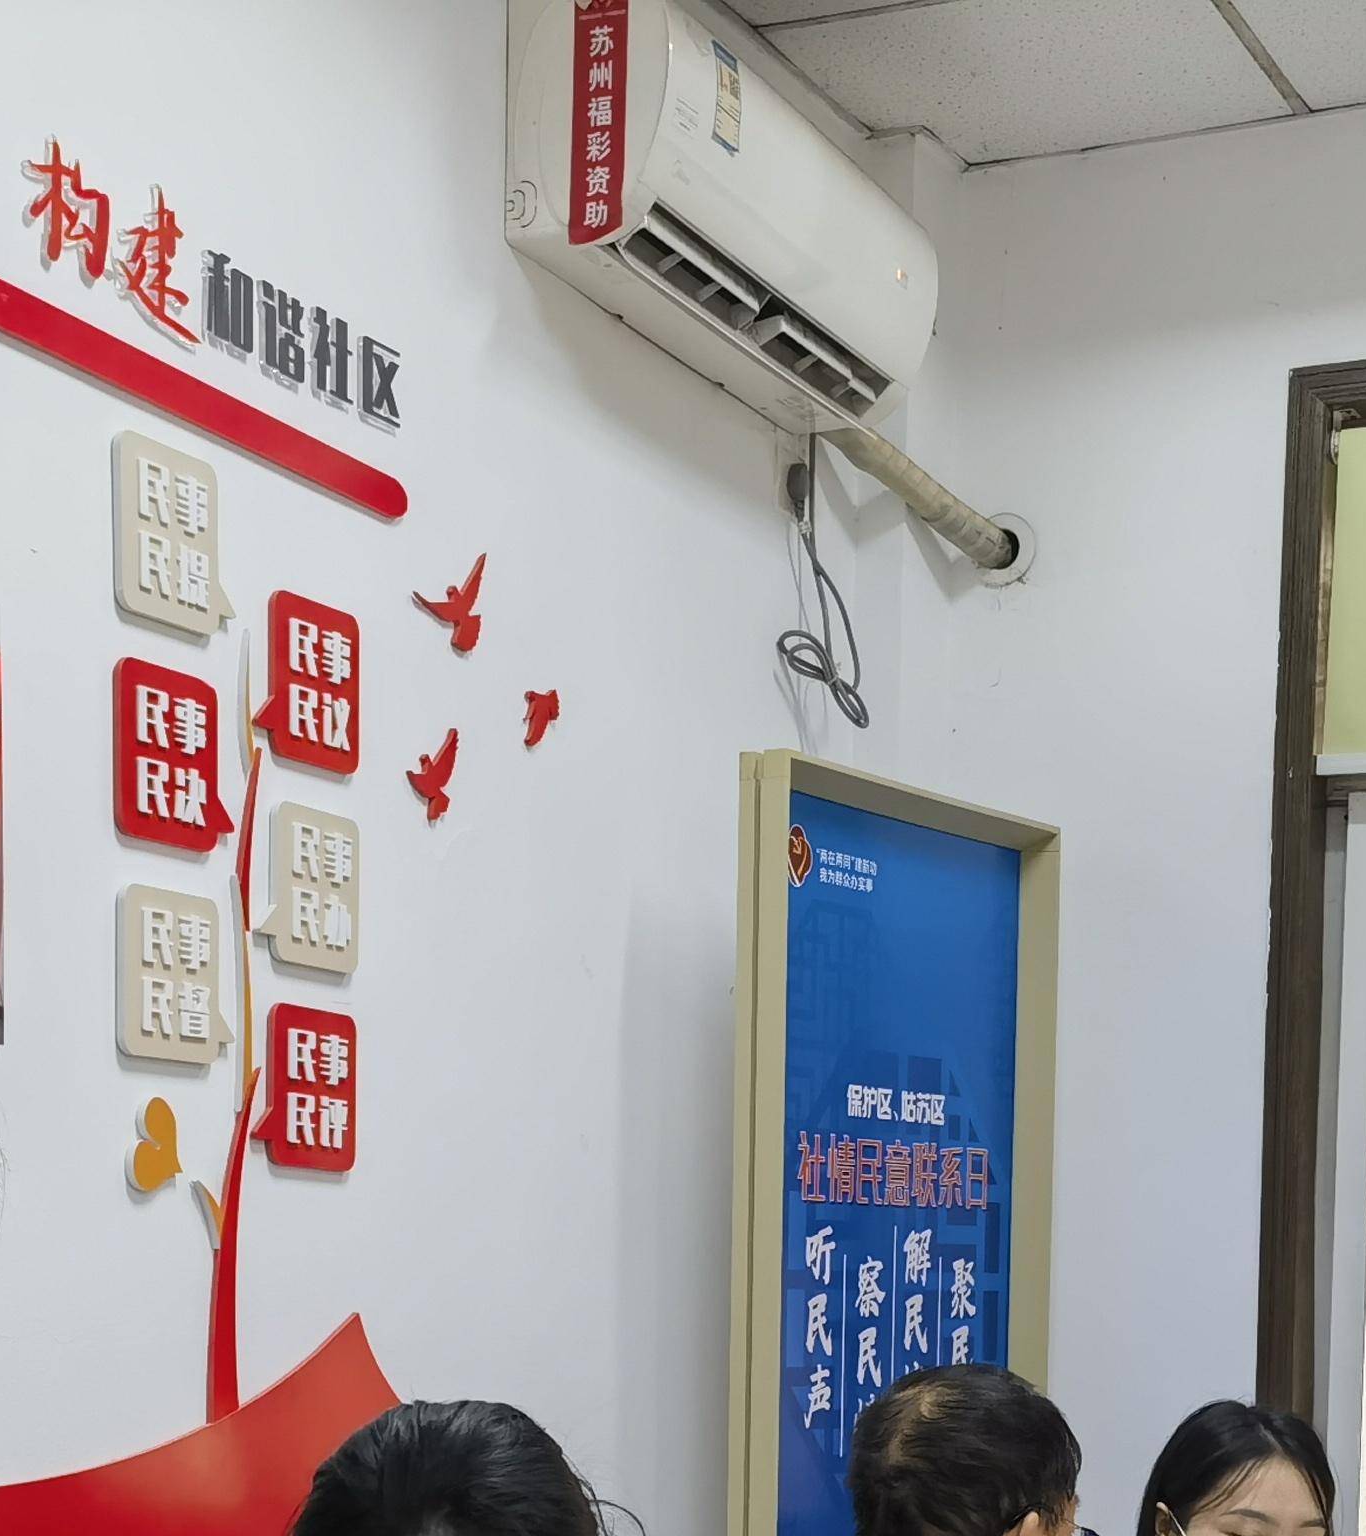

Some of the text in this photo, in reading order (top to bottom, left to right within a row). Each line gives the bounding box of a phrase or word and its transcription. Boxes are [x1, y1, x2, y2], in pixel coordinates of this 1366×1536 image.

[582, 25, 614, 229] 苏州福彩资助
[29, 138, 202, 344] 构建
[208, 250, 401, 428] 和谐社区
[137, 456, 209, 537] 民事
[289, 617, 351, 685] 民事
[136, 684, 207, 755] 民事
[289, 683, 351, 752] 民议
[136, 755, 207, 828] 民决
[292, 821, 353, 888] 民事
[141, 906, 211, 972] 民事
[291, 886, 352, 950] 民办
[141, 976, 211, 1039] 民督
[287, 1027, 350, 1086] 民事
[286, 1091, 348, 1150] 民评
[797, 1130, 989, 1210] 社情民意联系日
[803, 1225, 837, 1430] 听民声
[902, 1228, 933, 1374] 解民
[854, 1255, 886, 1426] 察民
